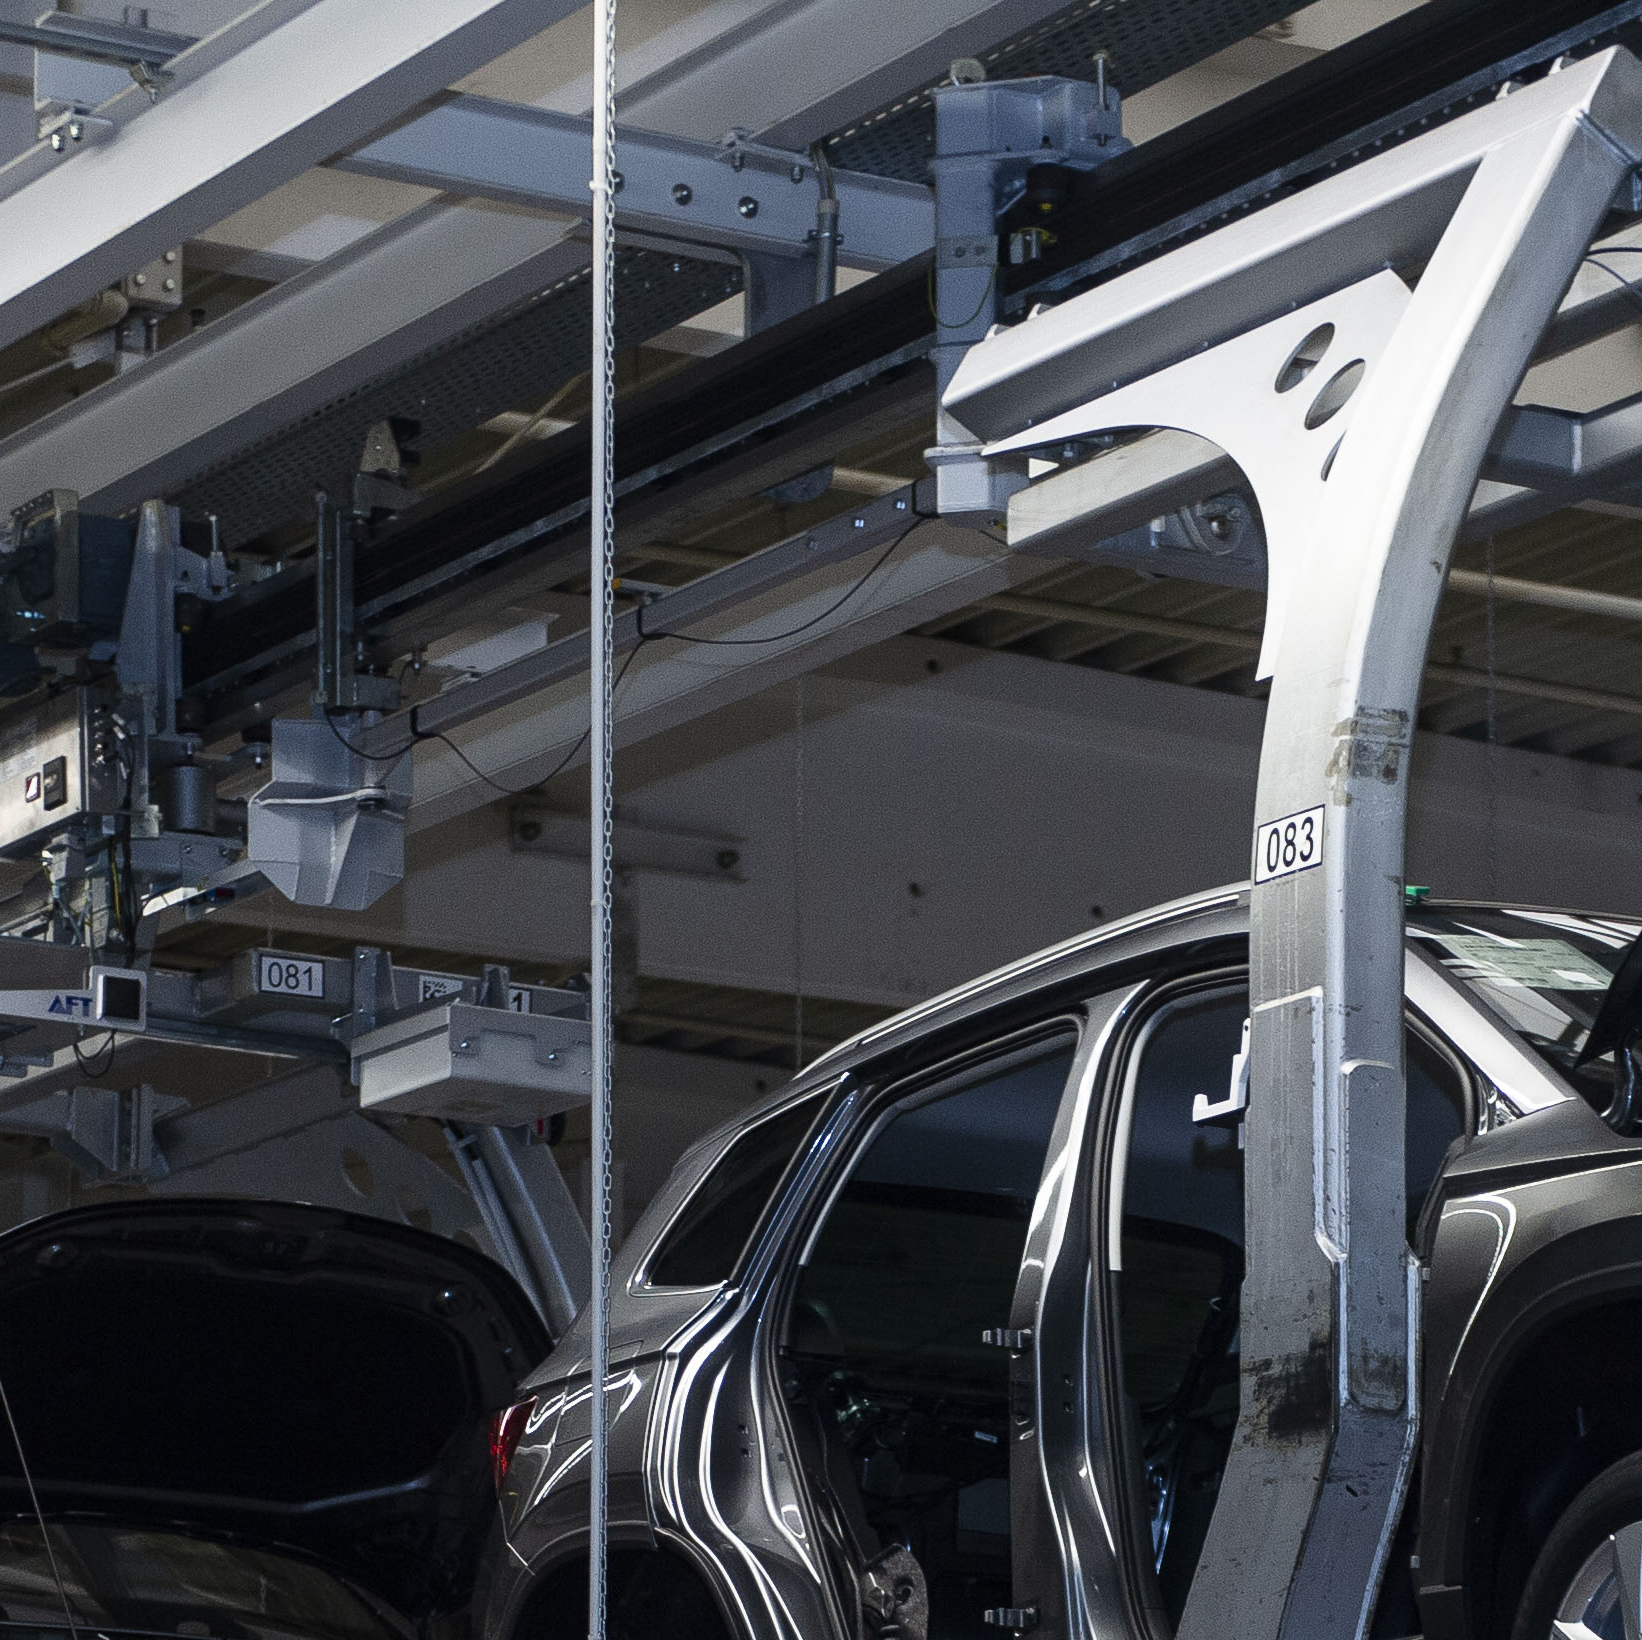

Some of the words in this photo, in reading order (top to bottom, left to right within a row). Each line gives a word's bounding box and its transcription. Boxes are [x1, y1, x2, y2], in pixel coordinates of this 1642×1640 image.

[1267, 816, 1314, 873] 083
[268, 961, 314, 992] 081
[48, 995, 93, 1017] AFT
